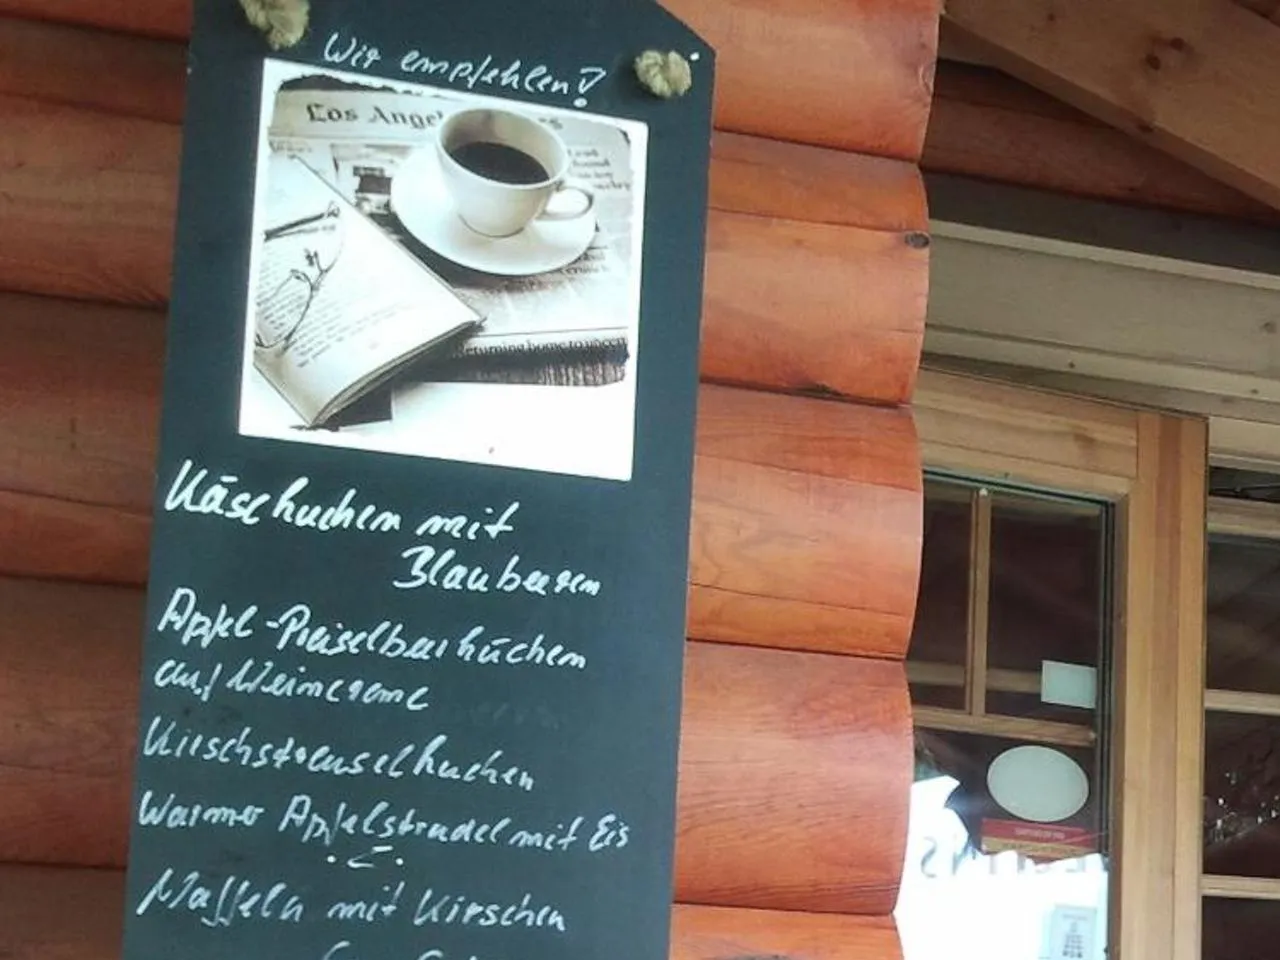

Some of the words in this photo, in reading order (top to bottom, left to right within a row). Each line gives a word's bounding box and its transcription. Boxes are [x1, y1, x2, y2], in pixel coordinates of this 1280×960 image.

[323, 31, 381, 69] Wir
[306, 103, 359, 122] Los
[414, 501, 520, 541] mit
[327, 880, 406, 923] mit
